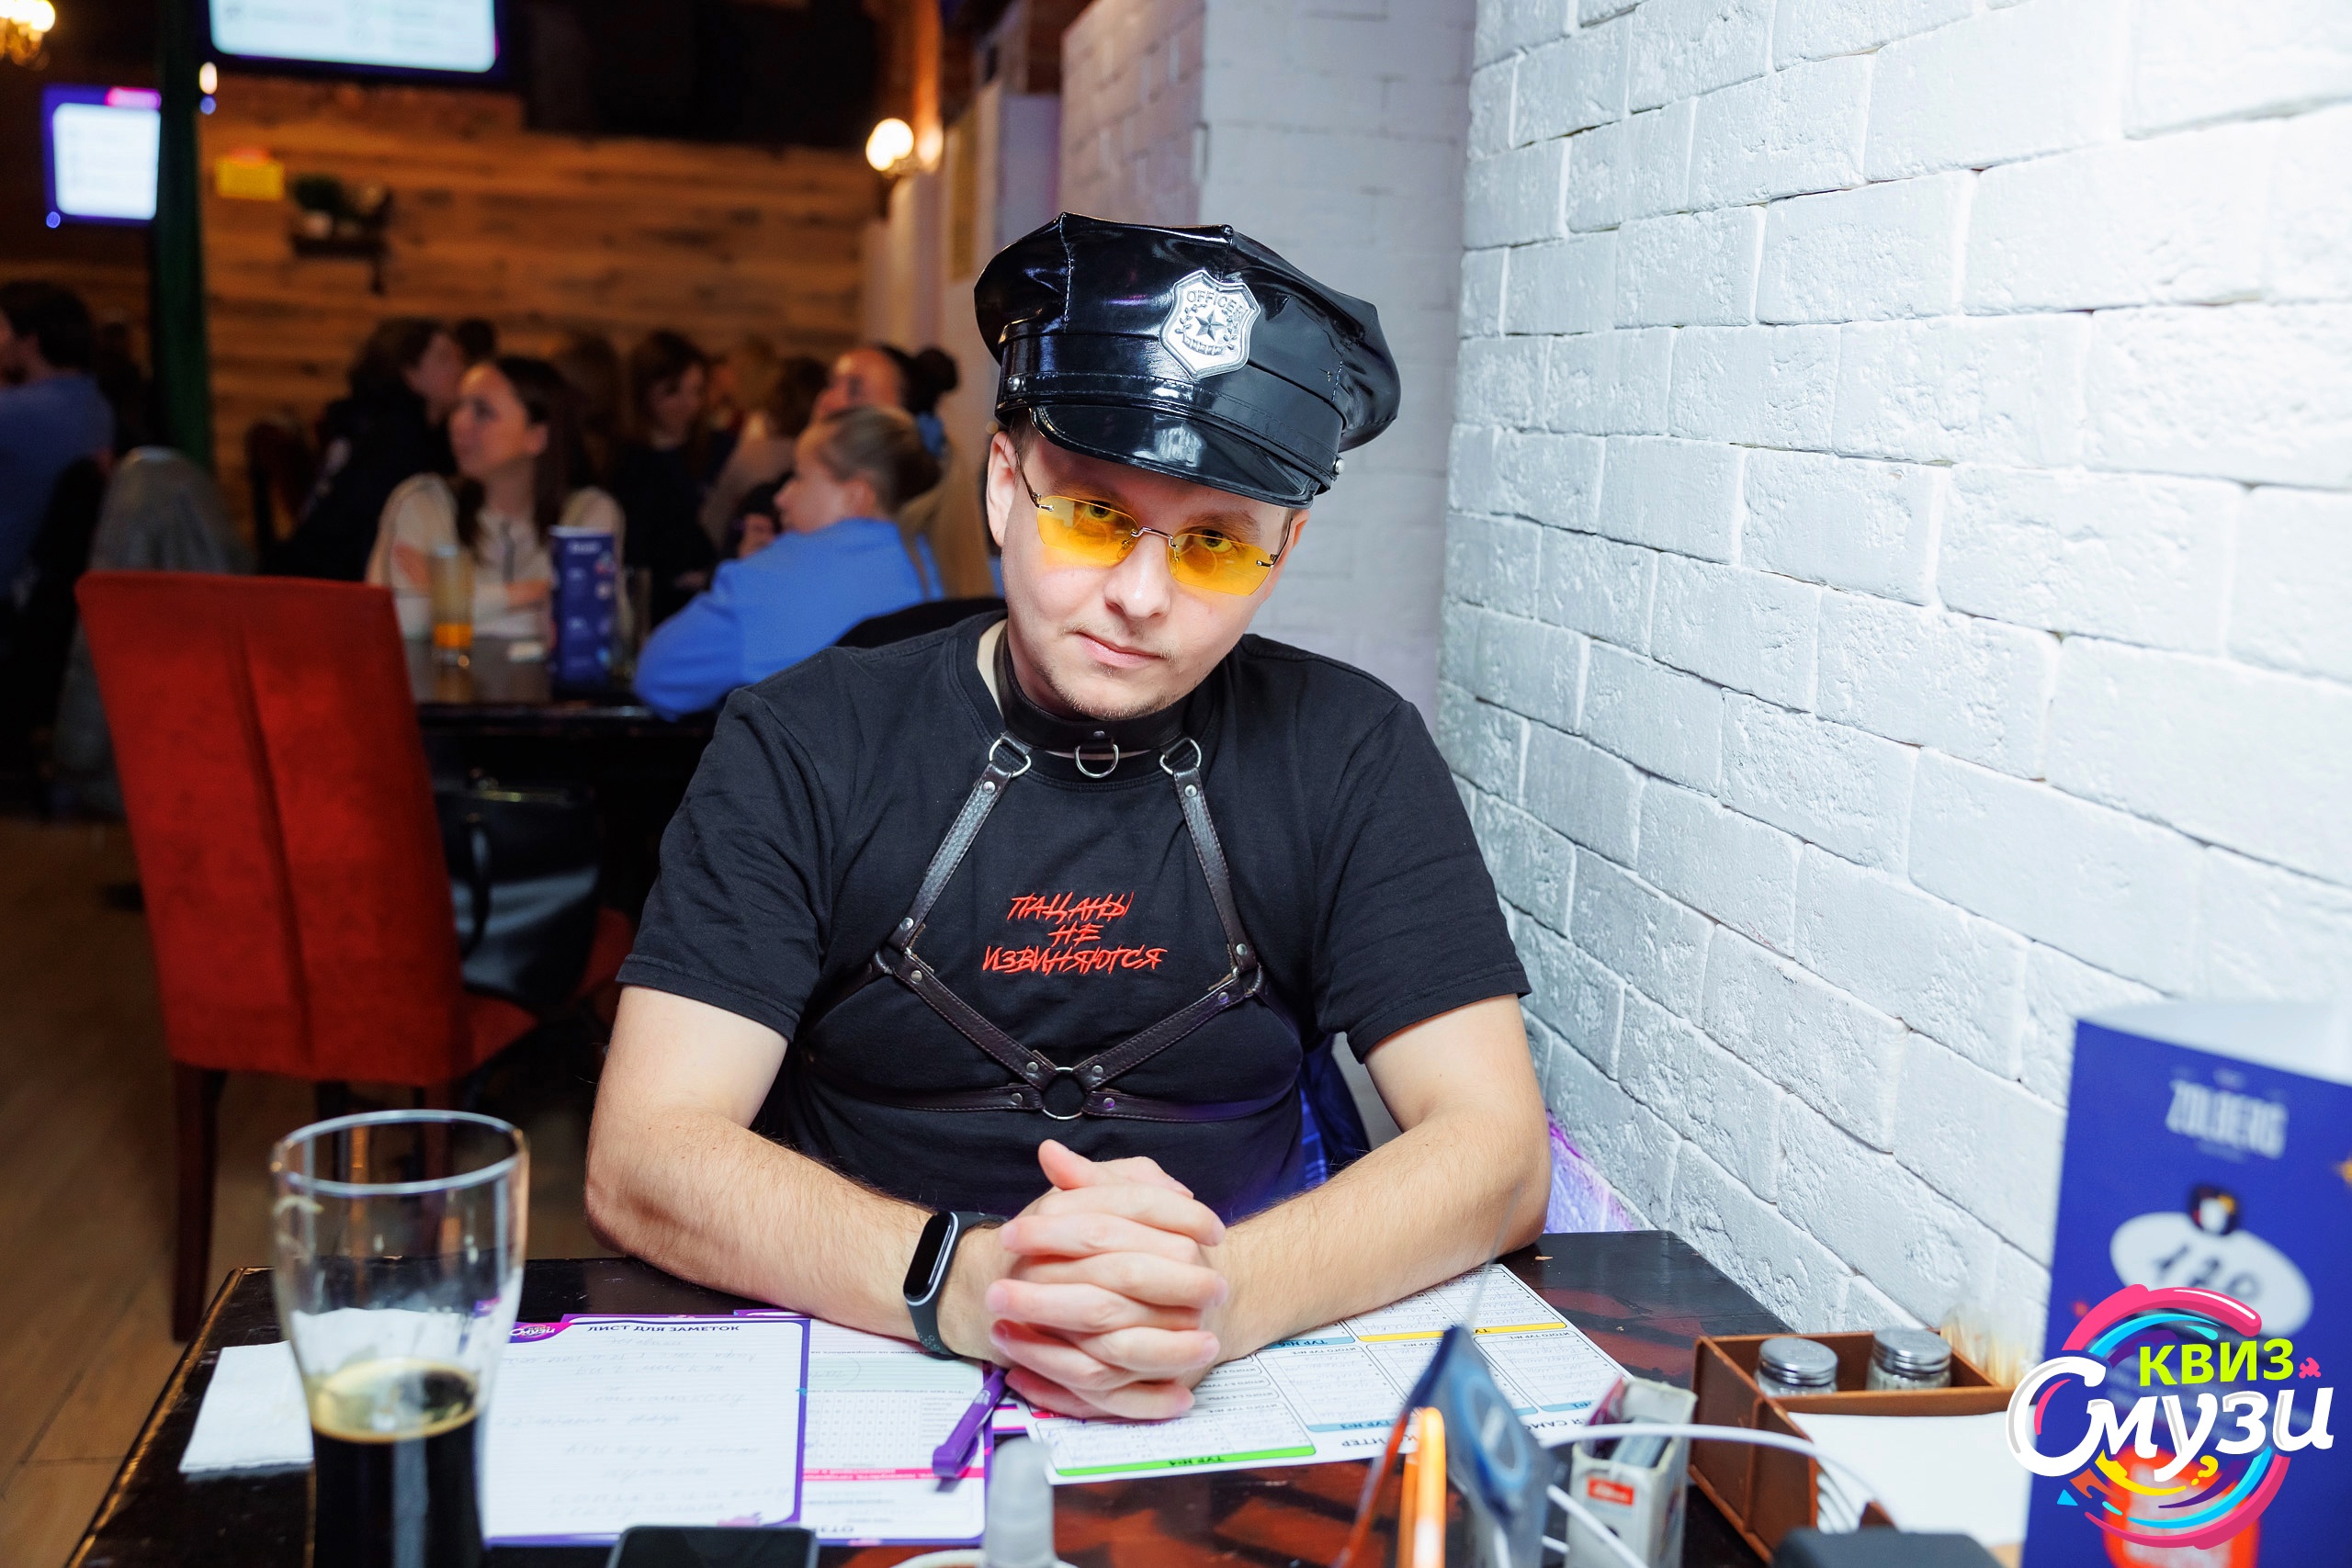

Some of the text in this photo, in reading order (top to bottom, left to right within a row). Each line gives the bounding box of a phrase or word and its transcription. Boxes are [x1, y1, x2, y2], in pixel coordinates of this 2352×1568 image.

[1186, 289, 1245, 319] OFFICER
[1007, 890, 1135, 924] ПАЦАНЫ
[1047, 919, 1104, 947] НЕ
[982, 943, 1168, 976] ИЗВИНЯЮТСЯ
[1198, 1455, 1225, 1463] ТУР
